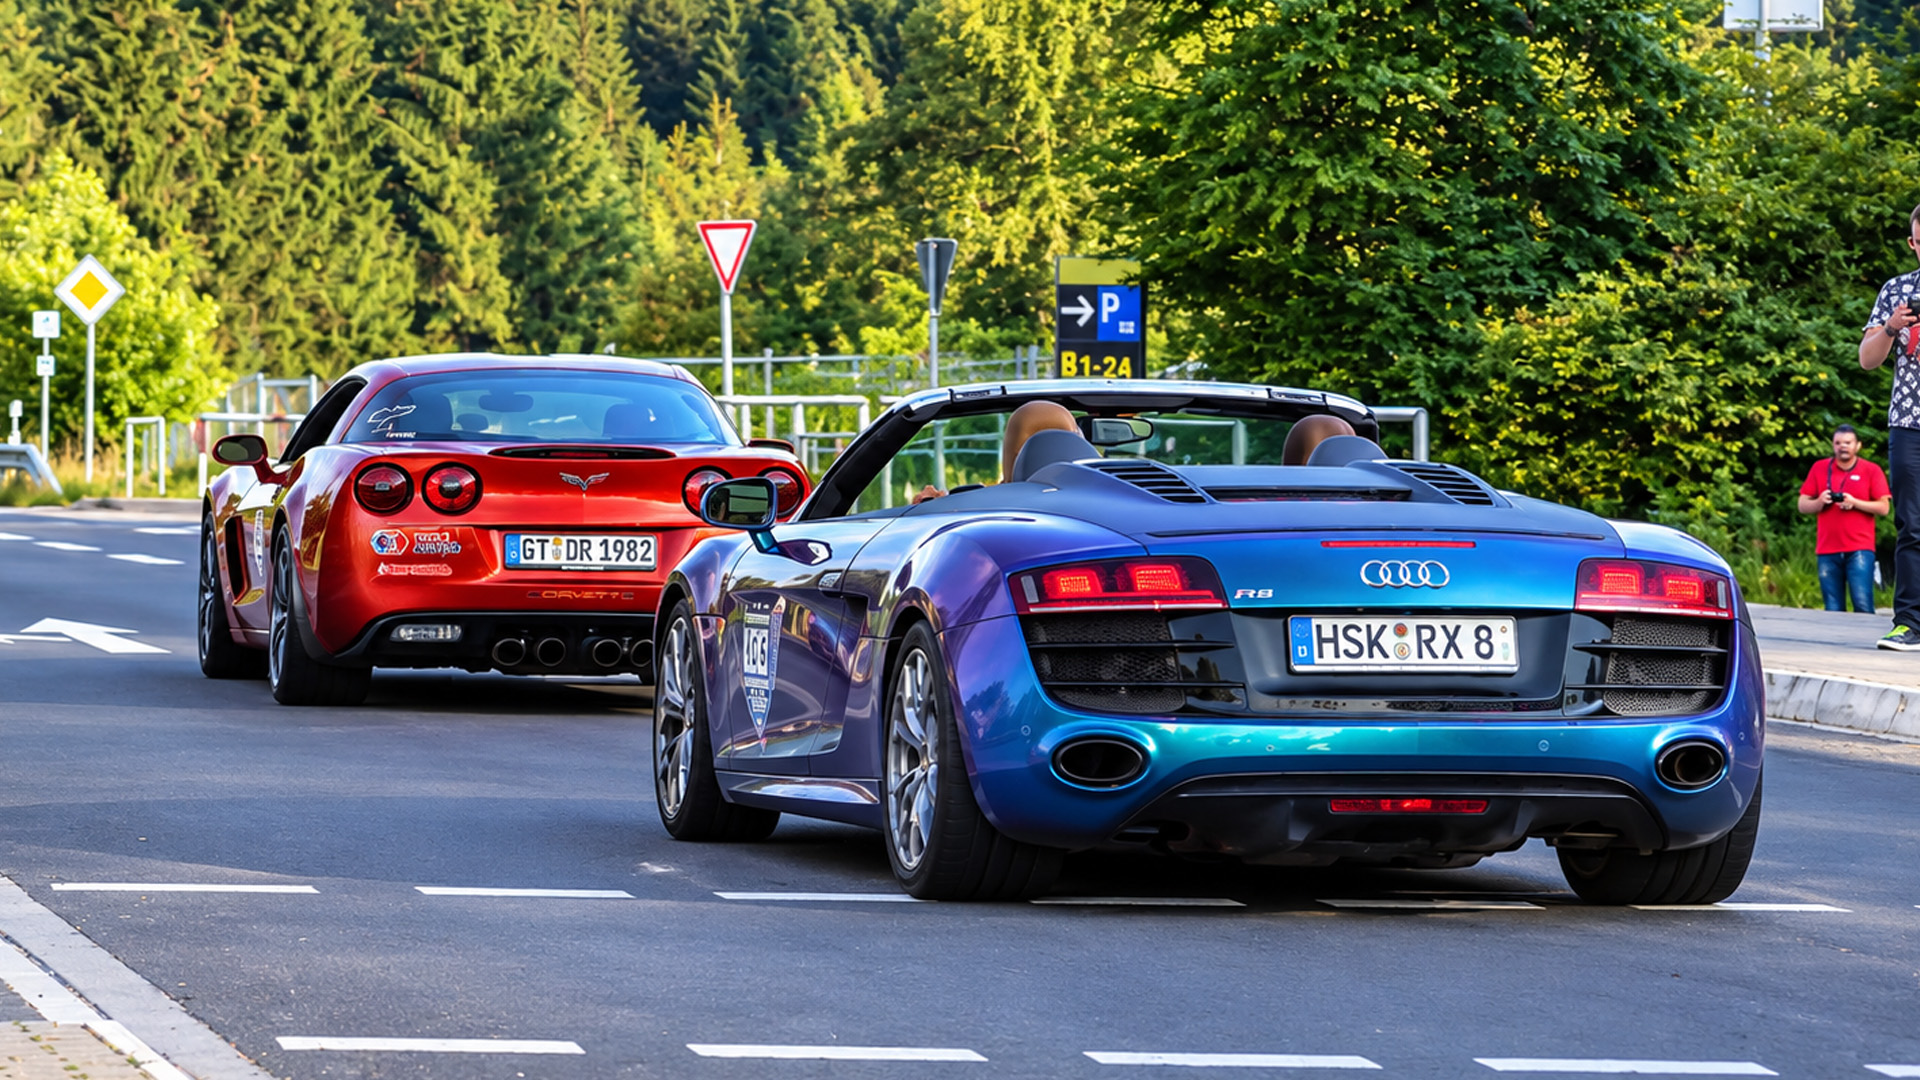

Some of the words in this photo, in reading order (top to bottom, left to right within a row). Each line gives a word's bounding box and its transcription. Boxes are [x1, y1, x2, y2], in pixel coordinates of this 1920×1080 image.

[1101, 292, 1120, 323] P
[522, 538, 550, 561] GT
[566, 539, 593, 561] DR
[599, 538, 652, 562] 1982
[1234, 589, 1273, 599] R8
[1316, 623, 1388, 659] HSK
[1416, 624, 1464, 659] RX
[1474, 624, 1495, 660] 8
